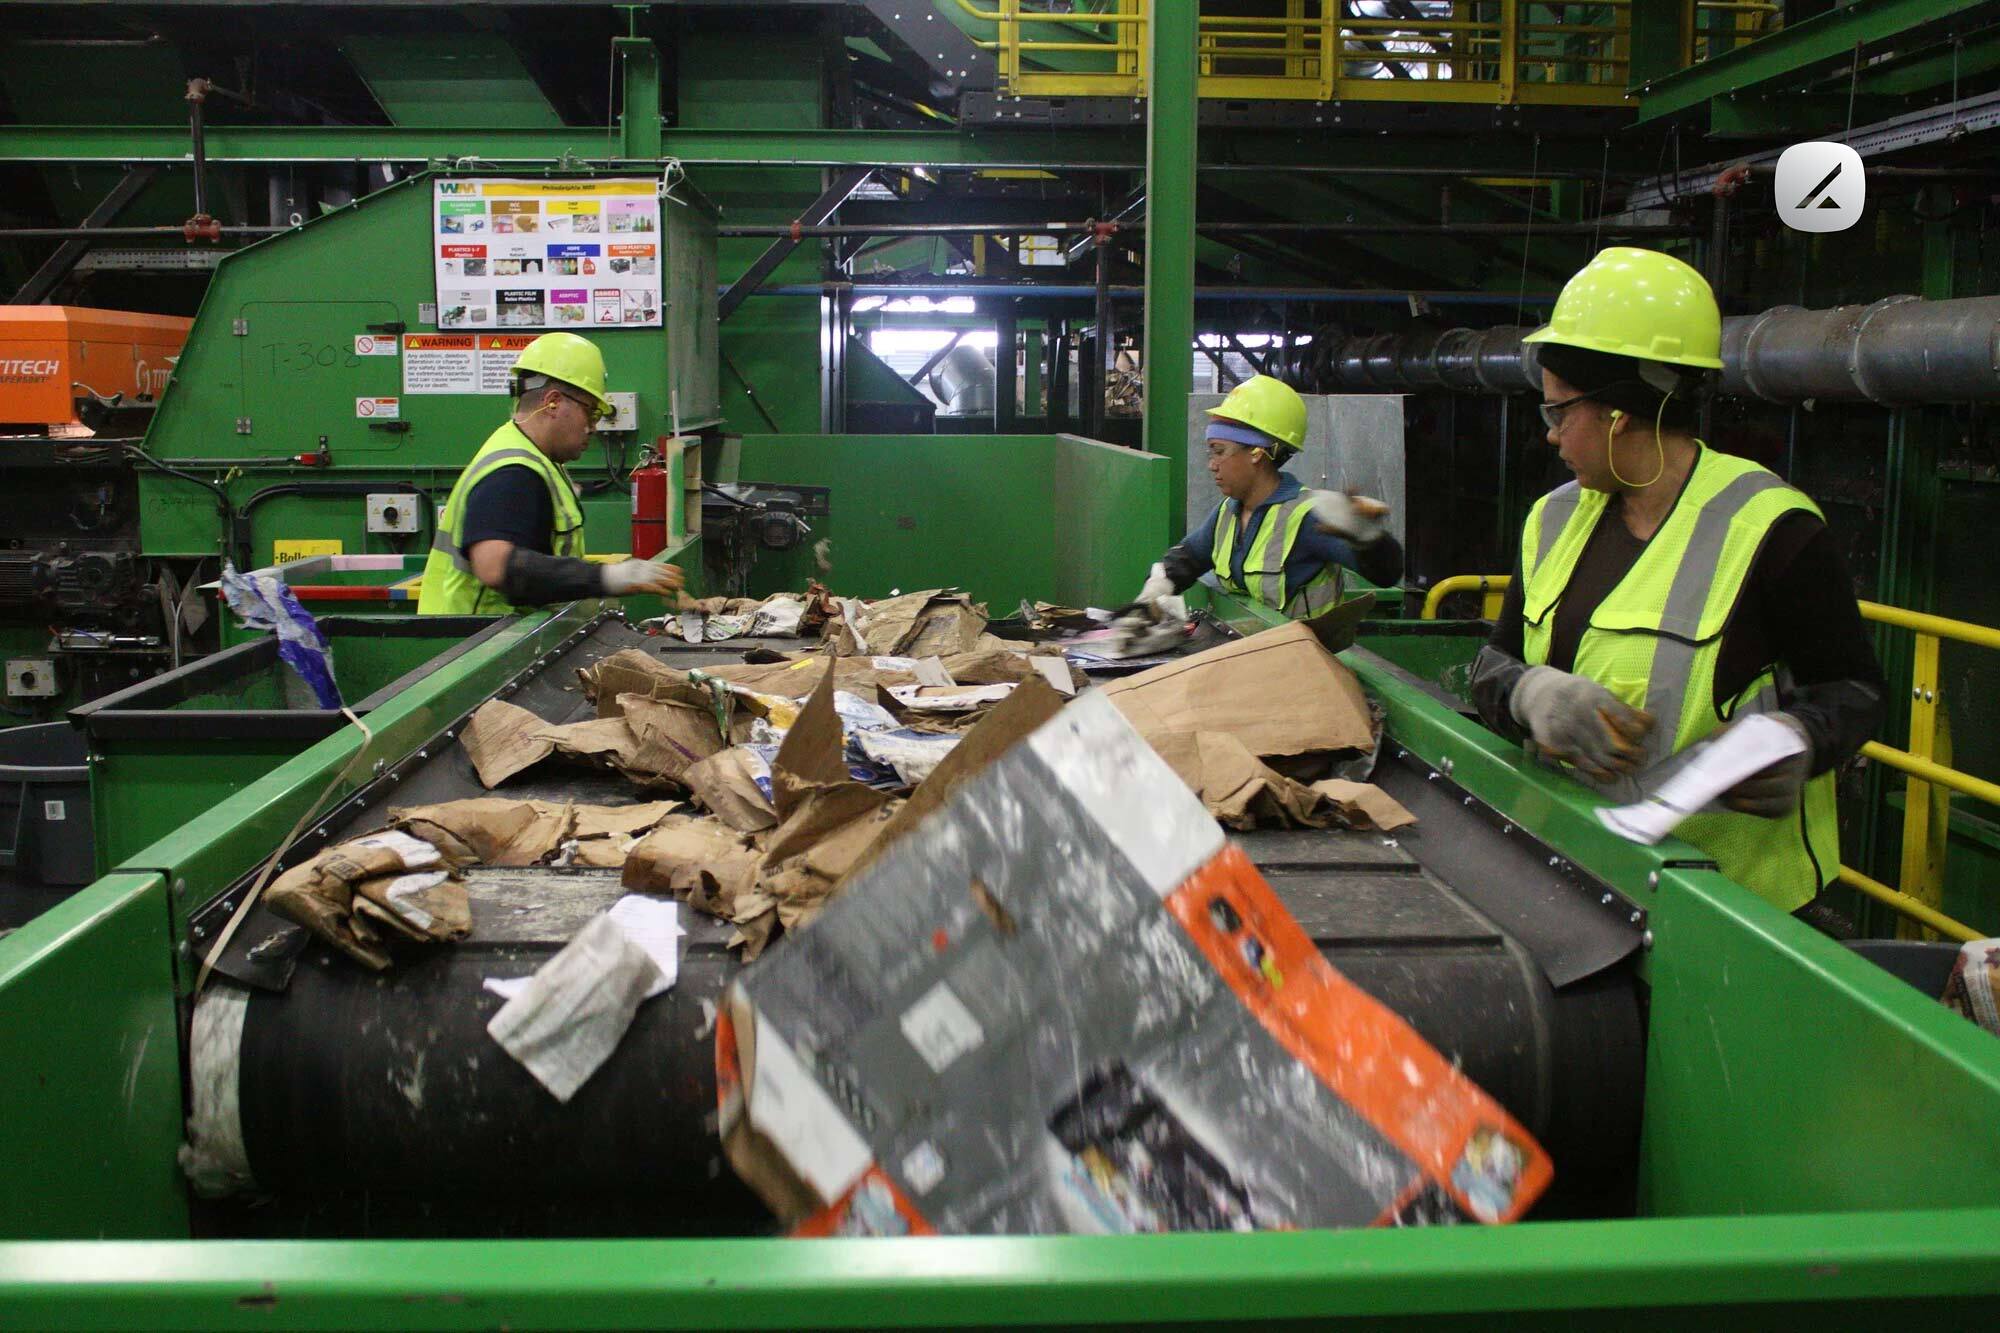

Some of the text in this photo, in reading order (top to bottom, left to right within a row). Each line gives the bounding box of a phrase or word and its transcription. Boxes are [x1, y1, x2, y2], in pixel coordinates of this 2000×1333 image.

[440, 183, 476, 194] WM
[422, 338, 471, 346] WARNING
[506, 338, 536, 347] AVIS
